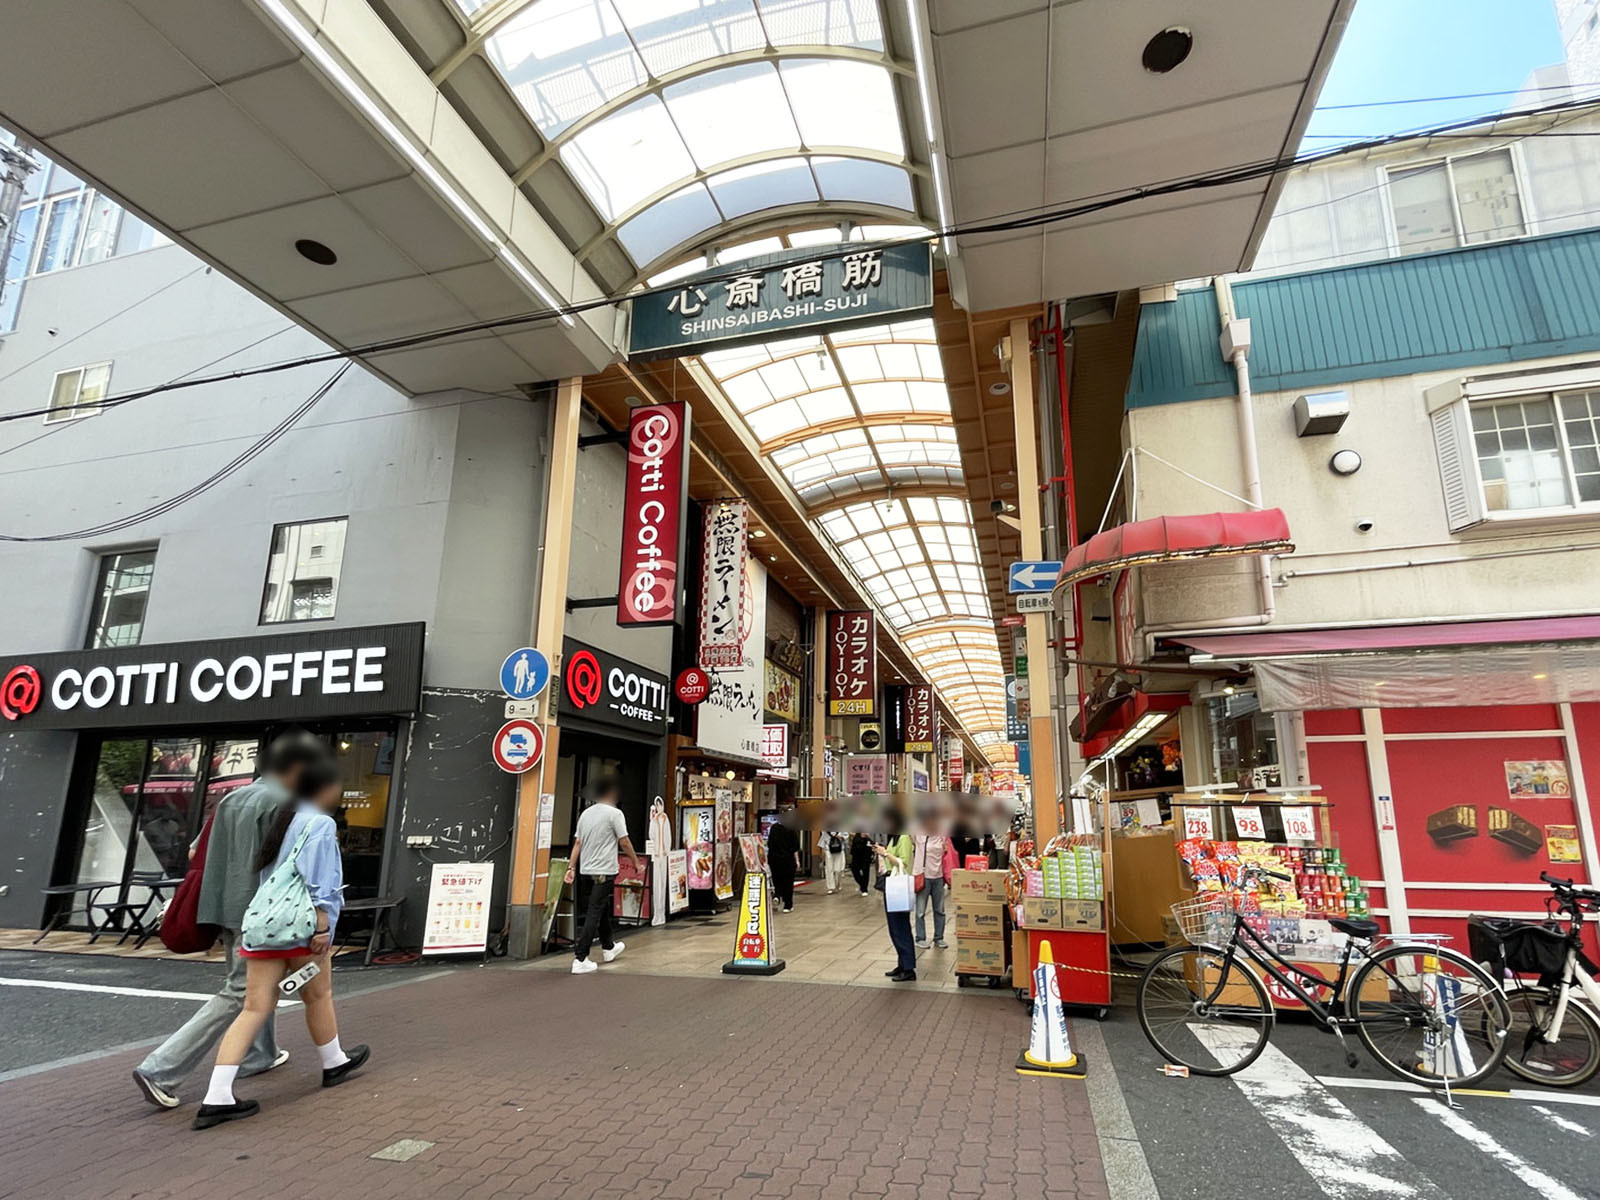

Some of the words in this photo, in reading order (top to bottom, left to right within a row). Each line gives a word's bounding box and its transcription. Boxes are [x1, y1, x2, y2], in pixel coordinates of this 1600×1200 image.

[667, 249, 883, 315] 心斎橋筋
[681, 293, 868, 336] SHINSAIBASHI-SUJI
[641, 415, 669, 492] Cotti
[634, 501, 665, 613] Coffee
[712, 508, 740, 636] 無限ラーメン
[835, 616, 848, 698] JOYJOY
[850, 616, 868, 697] カラオケ
[51, 662, 179, 711] COTTI
[190, 646, 386, 703] COFFEE
[608, 667, 665, 711] COTTI
[680, 686, 704, 694] COTTI
[620, 703, 653, 722] COFFEE
[838, 702, 866, 713] 24H
[917, 688, 929, 741] カラオケ
[1122, 808, 1134, 817] 89
[1187, 820, 1208, 834] 238
[1238, 819, 1260, 832] 98
[1286, 819, 1308, 833] 108
[441, 878, 482, 886] 緊急値下げ
